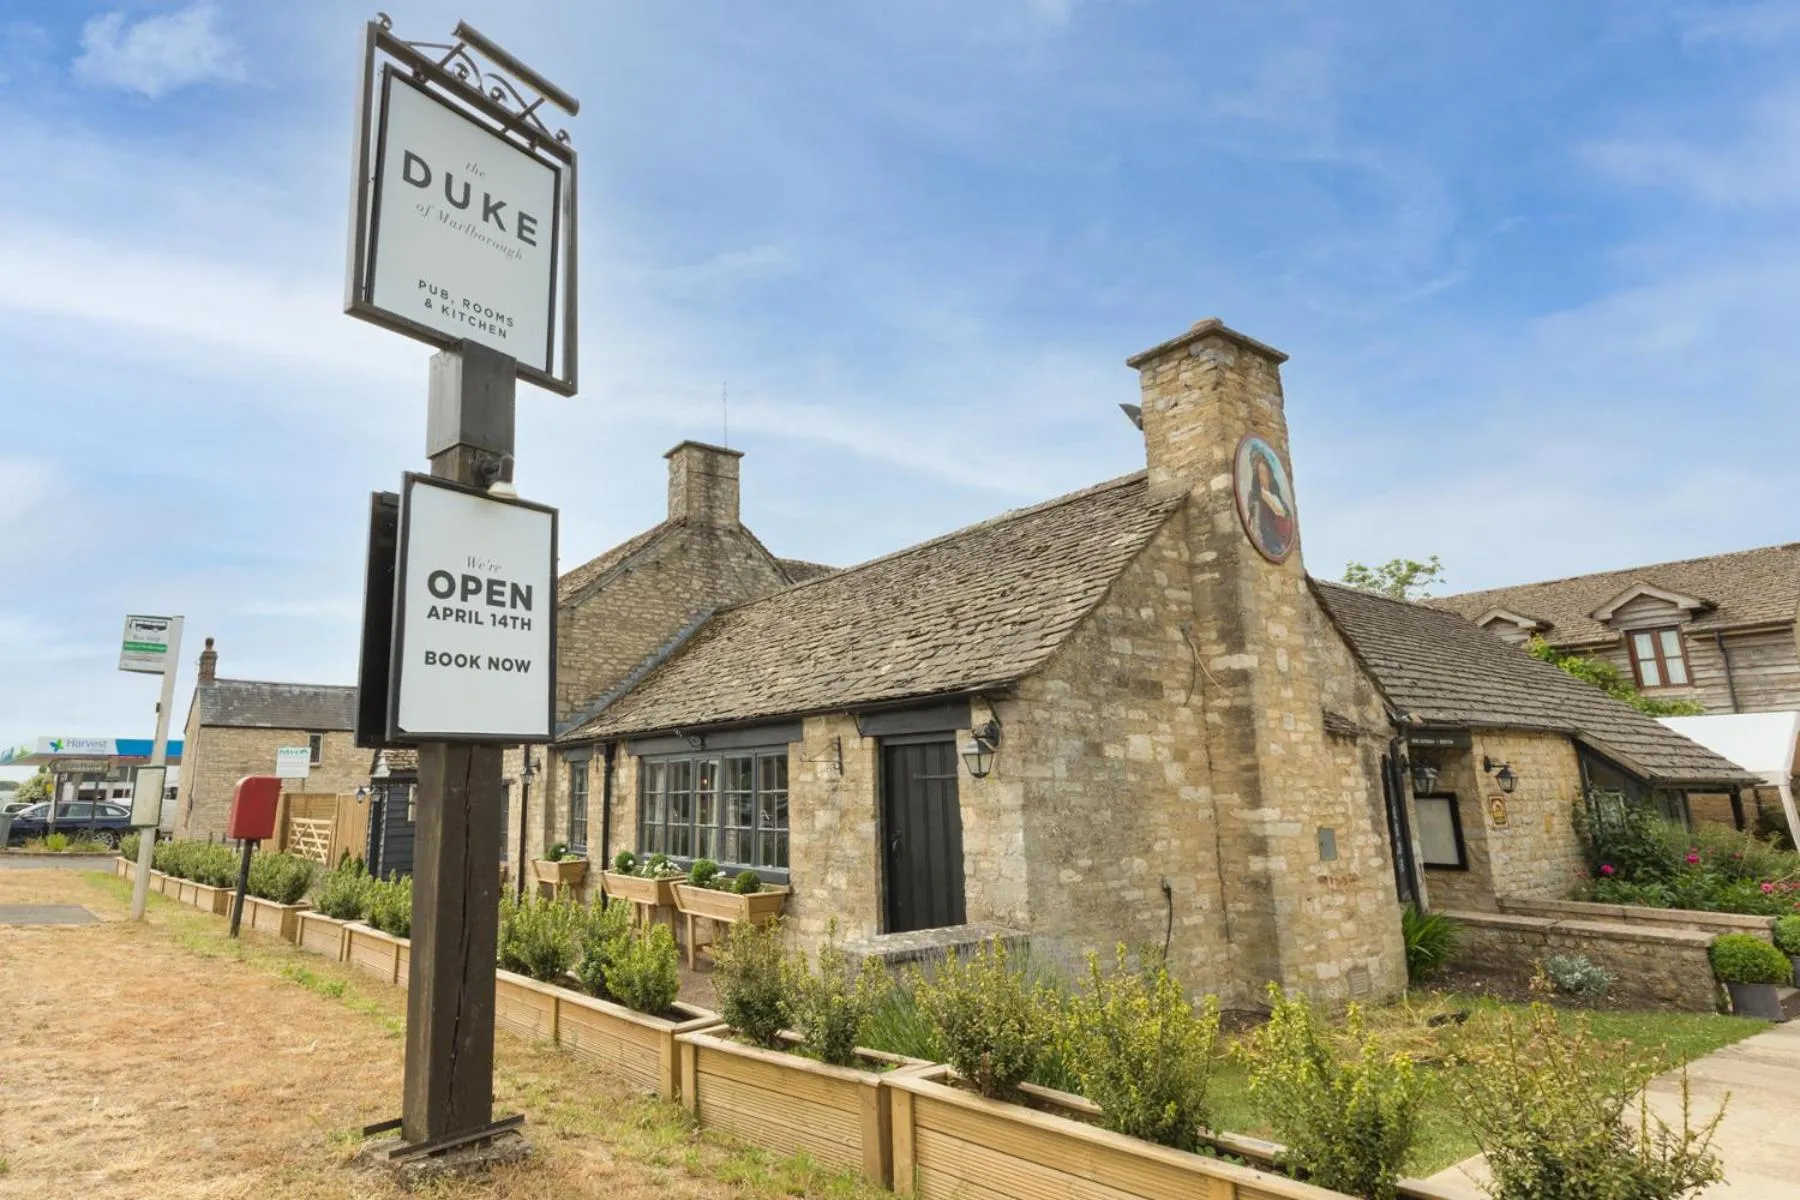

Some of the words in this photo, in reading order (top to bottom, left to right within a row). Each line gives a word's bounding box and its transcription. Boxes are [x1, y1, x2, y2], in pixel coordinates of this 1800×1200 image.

[465, 161, 486, 178] the
[403, 150, 537, 247] DUKE
[416, 203, 434, 219] of
[439, 210, 522, 260] Marlborough
[424, 298, 433, 309] &
[441, 304, 507, 339] KITCHEN
[462, 298, 514, 328] ROOMS
[467, 556, 501, 571] We're
[427, 570, 532, 611] OPEN
[427, 605, 484, 625] APRIL
[490, 613, 531, 631] 14TH
[424, 650, 481, 669] BOOK
[487, 656, 531, 673] NOW
[66, 738, 108, 749] Harvest
